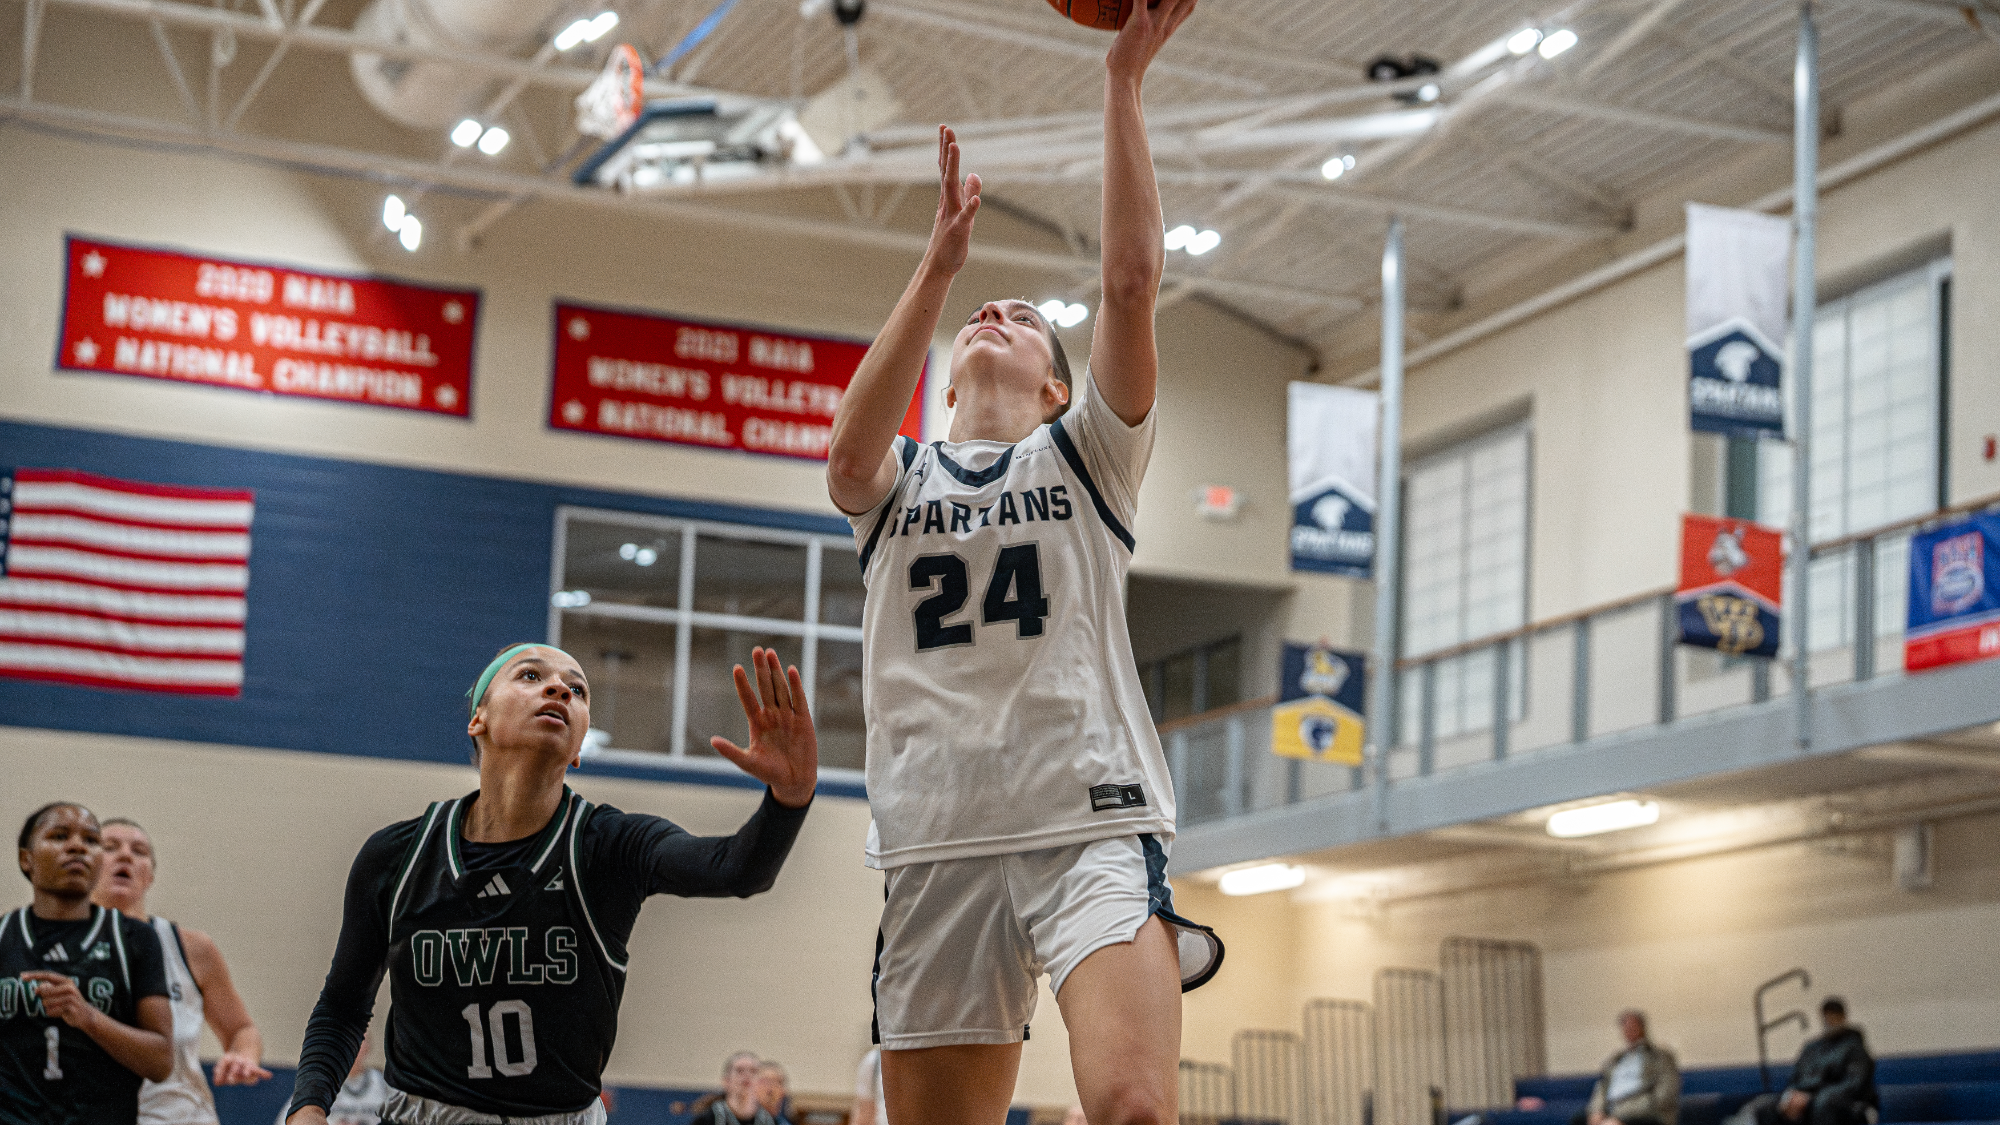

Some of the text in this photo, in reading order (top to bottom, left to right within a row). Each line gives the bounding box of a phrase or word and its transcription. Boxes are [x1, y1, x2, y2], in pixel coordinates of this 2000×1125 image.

[282, 274, 356, 314] NAIA
[104, 292, 439, 367] WOMEN'S VOLLEYBALL
[748, 335, 814, 373] NAIA
[114, 336, 422, 406] NATIONAL CHAMPION
[721, 372, 846, 418] VOLLEYB
[598, 400, 834, 456] NATIONAL CHAMP
[907, 540, 1051, 653] 24
[1128, 791, 1136, 800] L
[411, 926, 578, 987] OWLS
[43, 1026, 63, 1080] 1
[461, 1000, 538, 1079] 10
